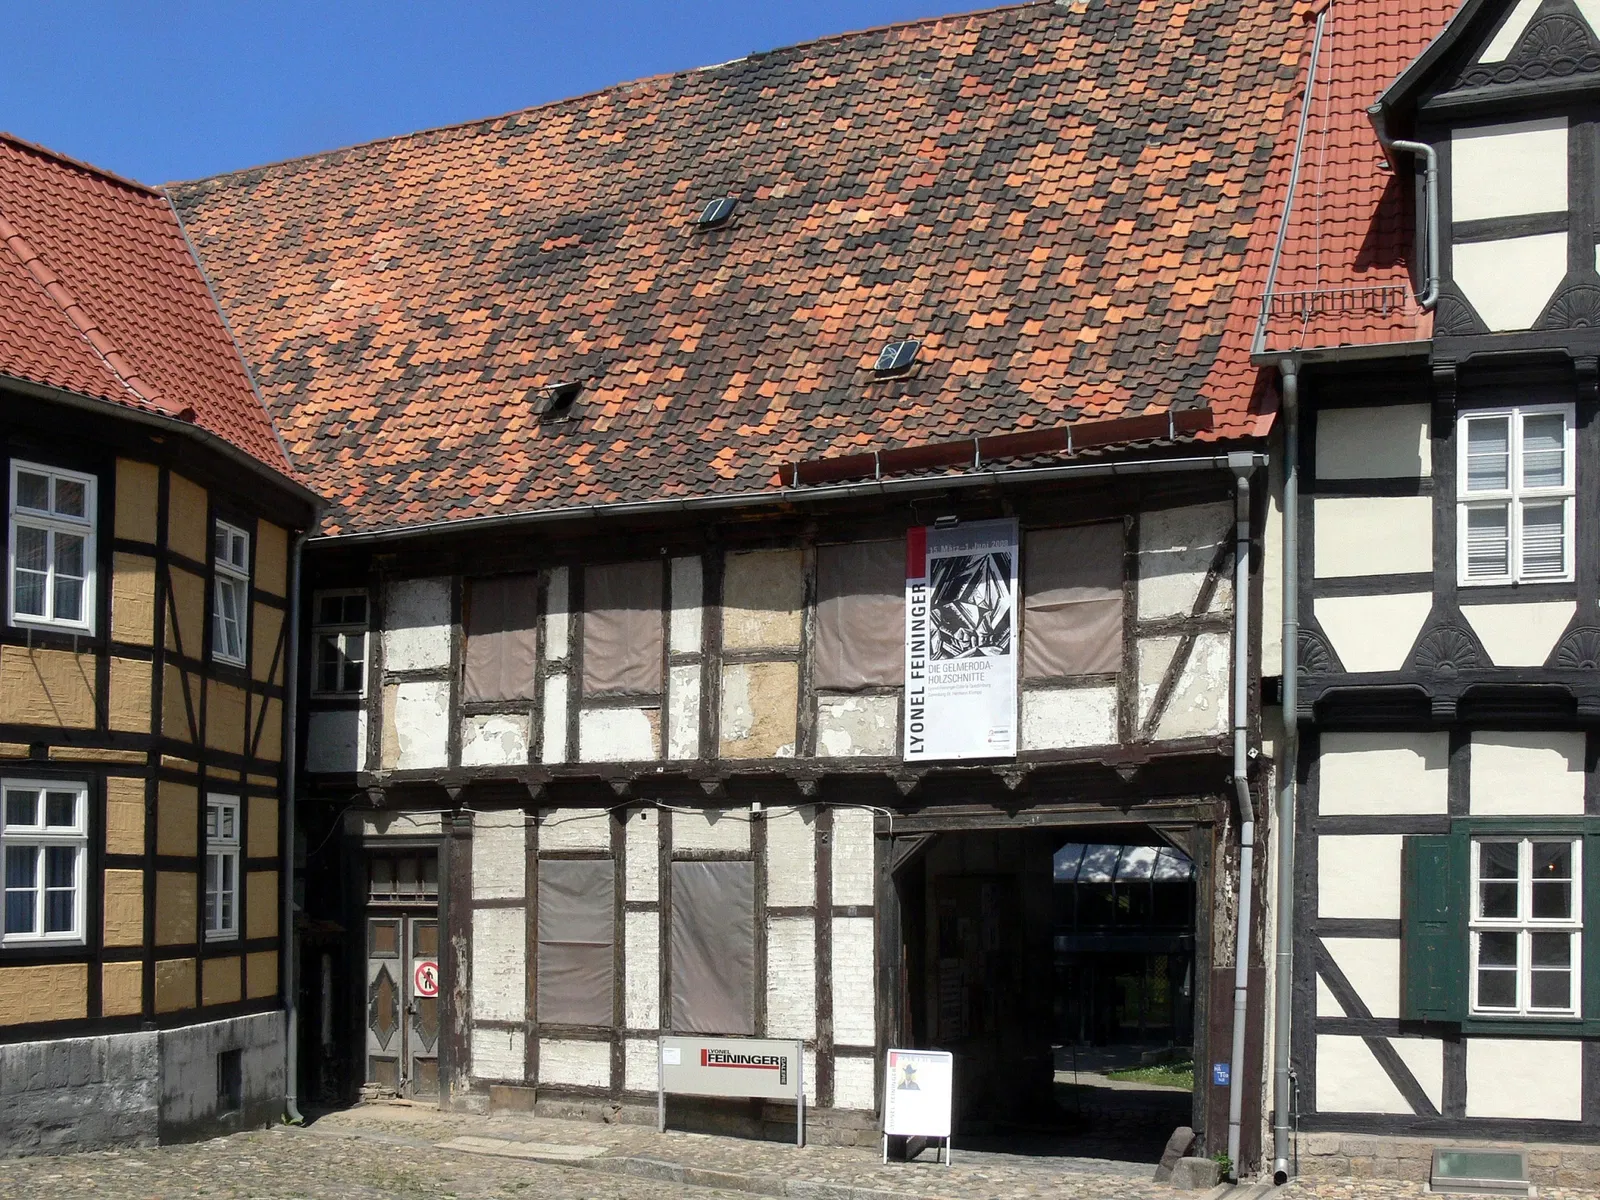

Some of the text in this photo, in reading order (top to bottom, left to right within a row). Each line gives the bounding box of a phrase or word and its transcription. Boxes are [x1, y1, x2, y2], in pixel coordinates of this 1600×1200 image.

[910, 583, 926, 754] LYONEL FEININGER
[928, 661, 993, 674] DIE GELMERODA-
[928, 672, 985, 684] HOLZSCHNITTE
[708, 1053, 779, 1065] FEININGER
